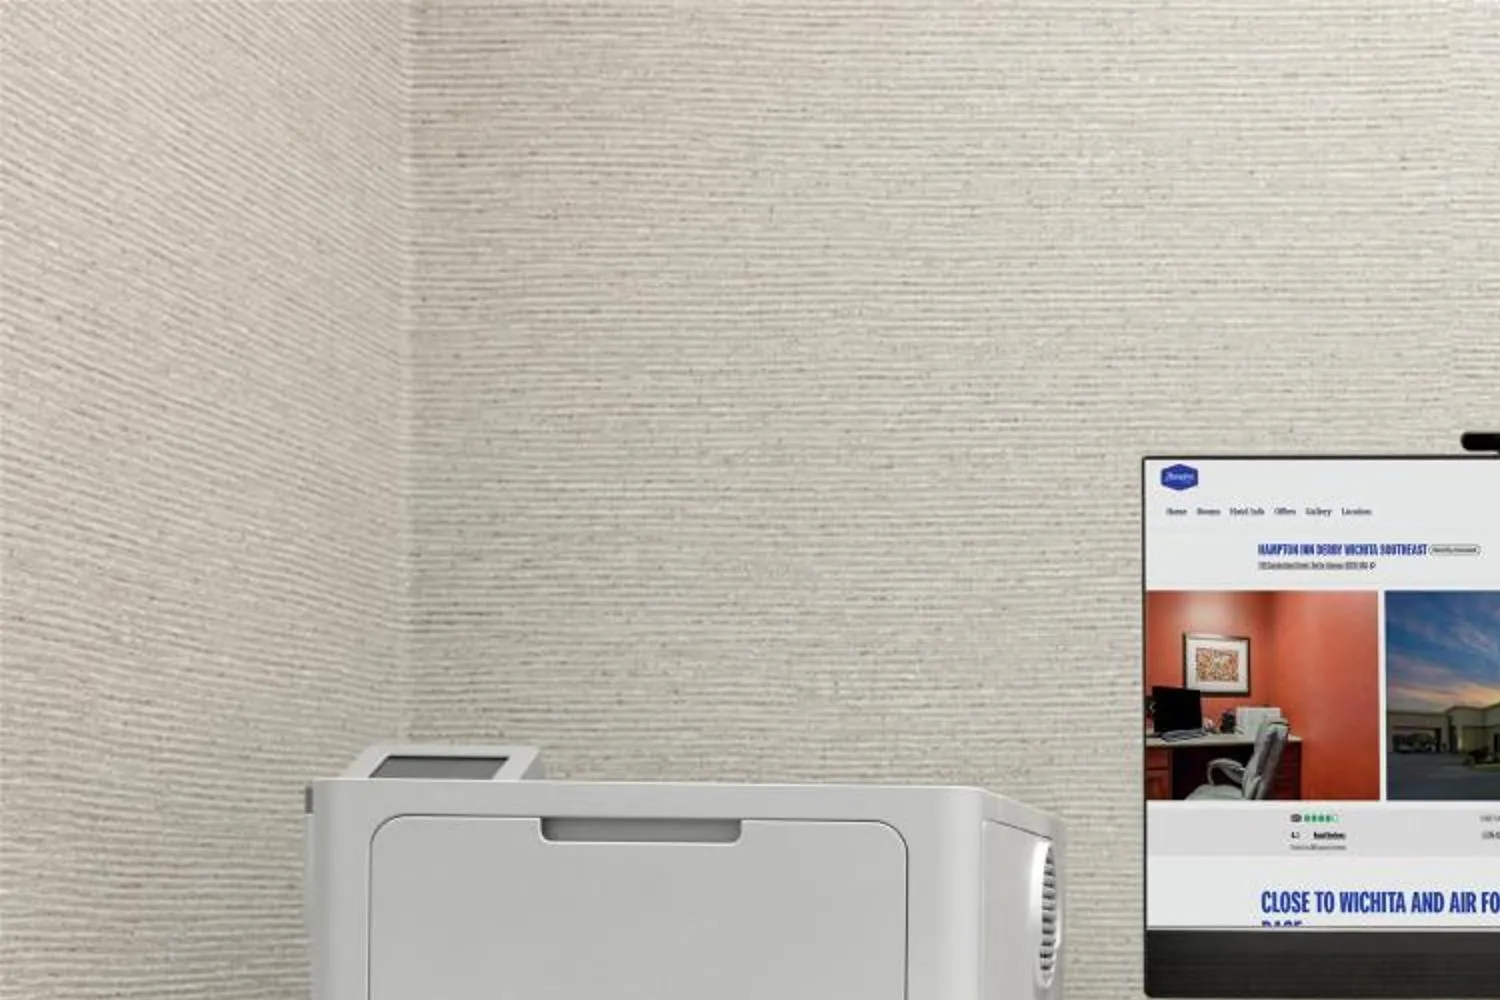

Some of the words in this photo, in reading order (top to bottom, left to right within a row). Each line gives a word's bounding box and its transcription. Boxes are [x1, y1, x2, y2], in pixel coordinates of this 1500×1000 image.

[1380, 543, 1428, 556] SOUTHEAST
[1260, 890, 1310, 914] CLOSE
[1313, 890, 1335, 914] TO
[1339, 890, 1407, 914] WICHITA
[1410, 890, 1445, 914] AND
[1448, 890, 1478, 914] AIR
